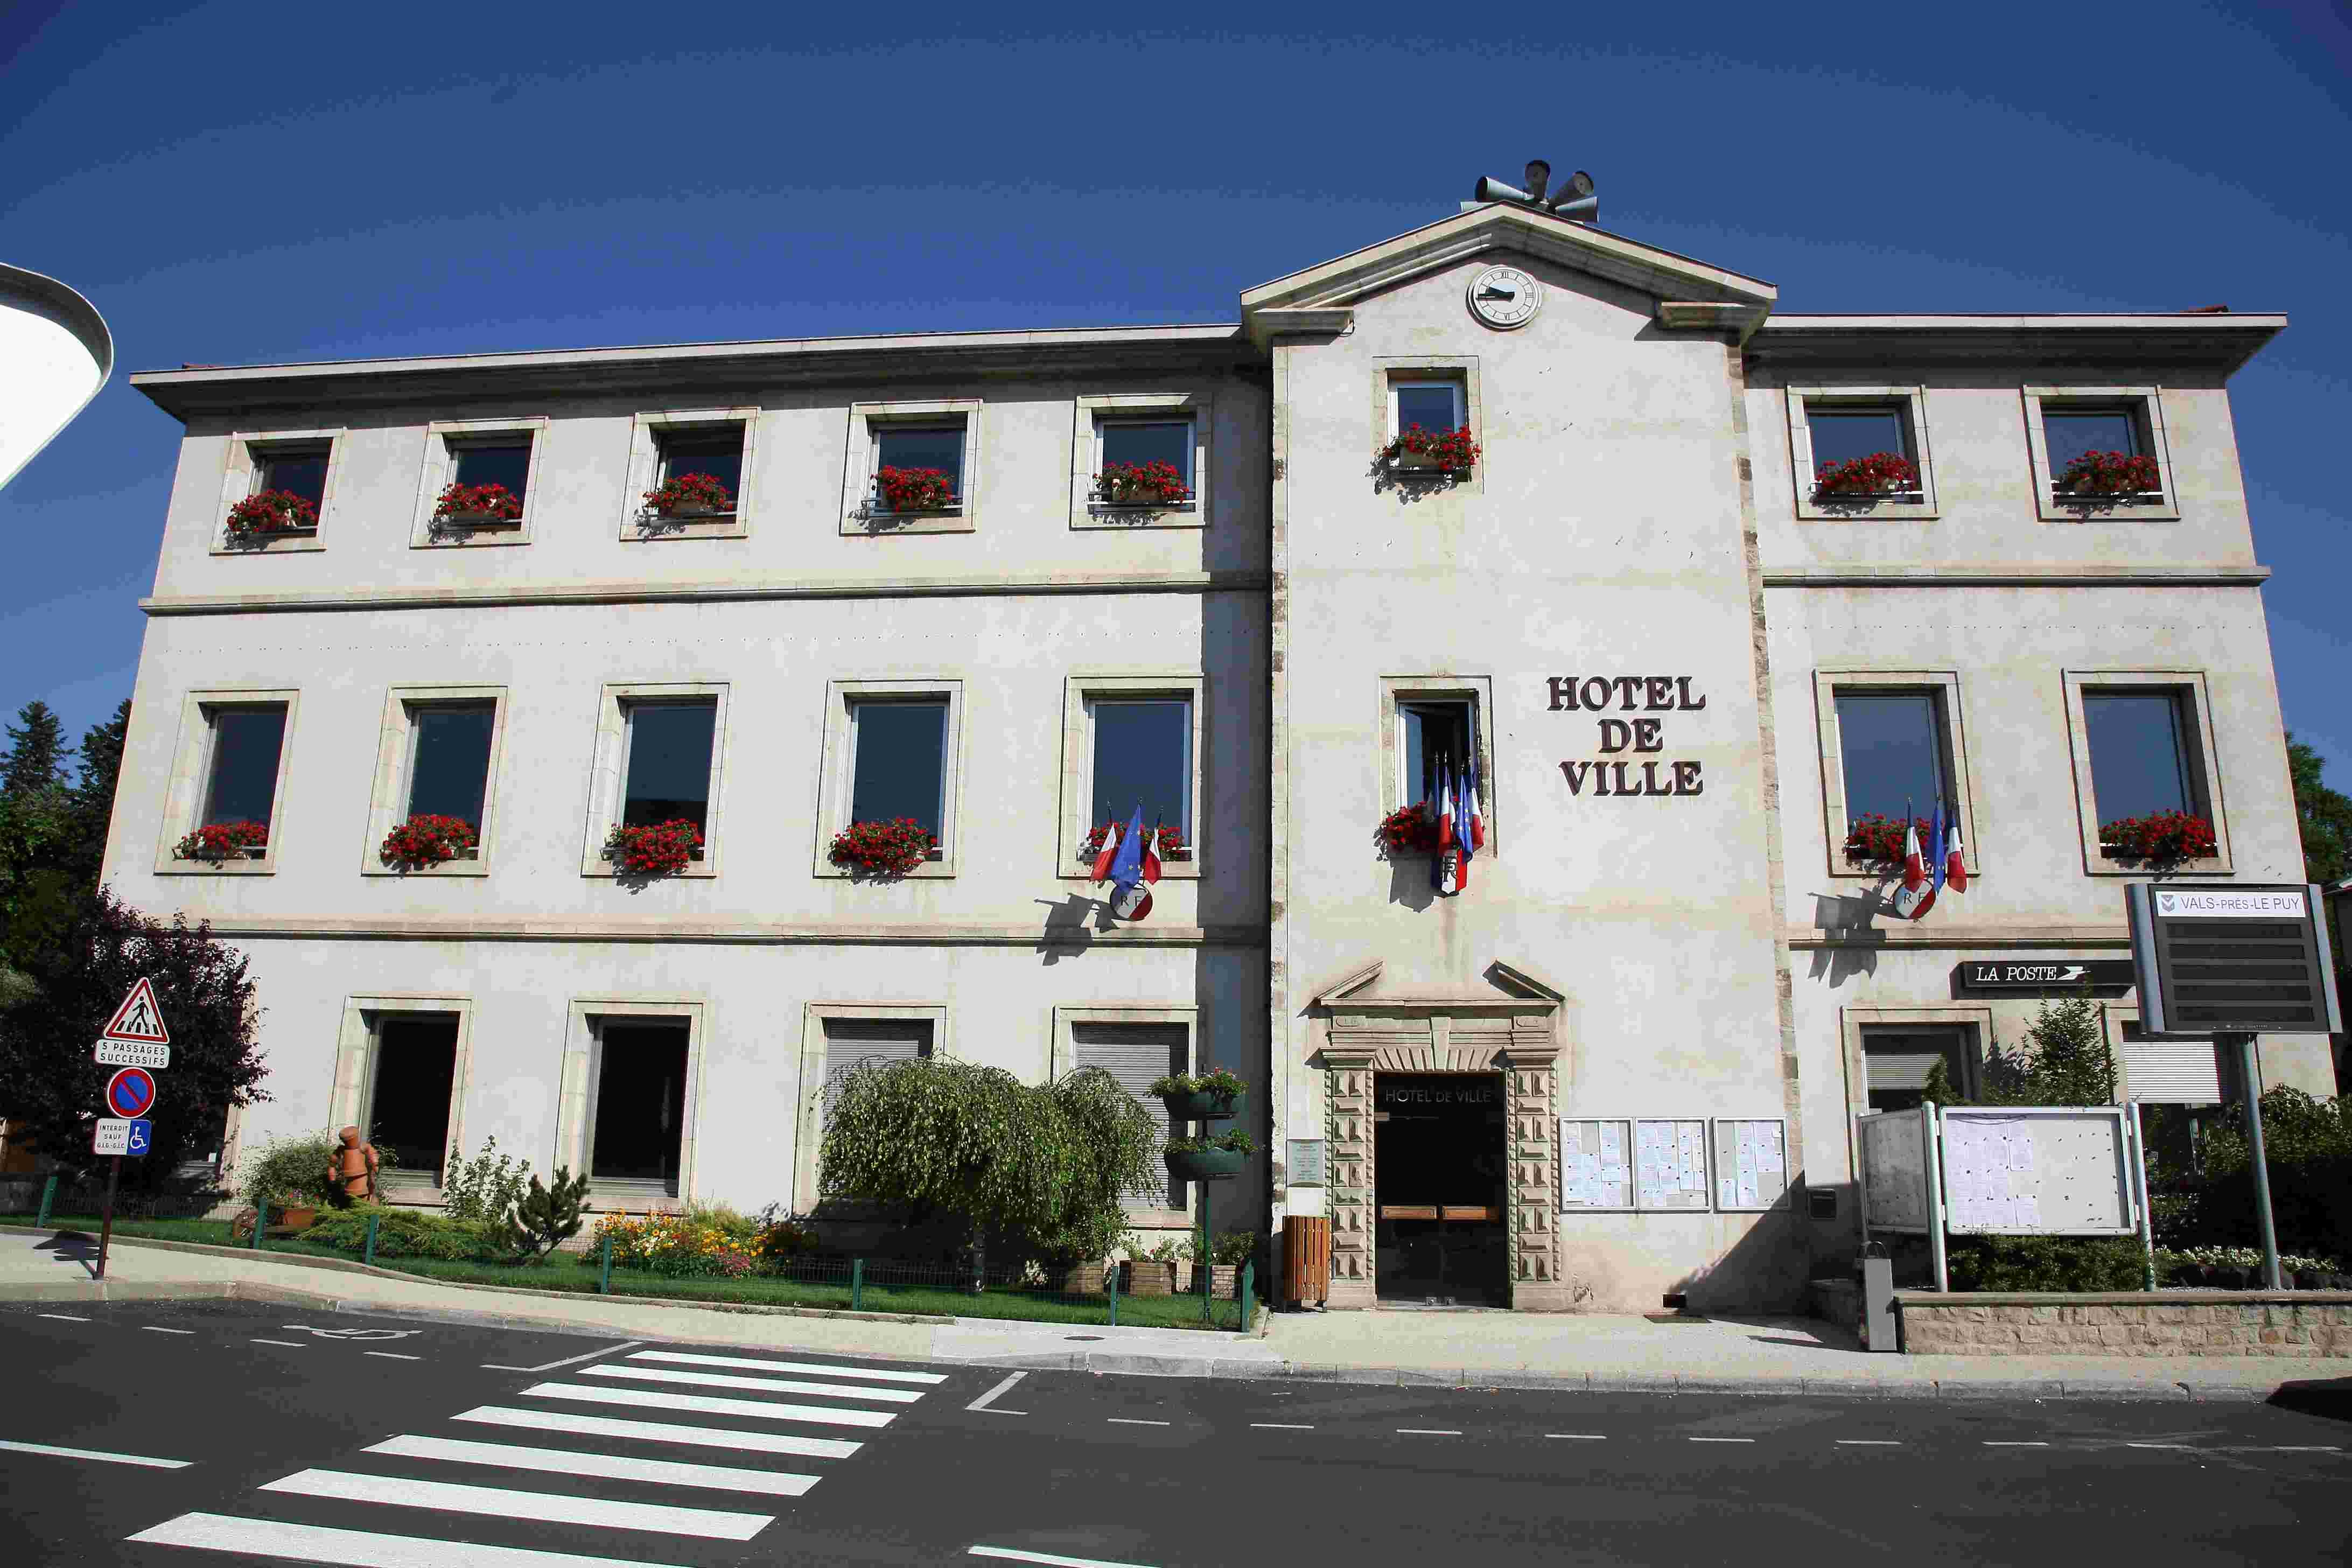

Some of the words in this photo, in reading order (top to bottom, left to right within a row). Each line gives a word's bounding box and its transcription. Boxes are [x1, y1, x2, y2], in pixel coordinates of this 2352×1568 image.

[1546, 676, 1706, 711] HOTEL
[1597, 718, 1663, 753] DE
[1559, 761, 1704, 796] VILLE
[2274, 898, 2299, 909] PUY
[1976, 967, 1999, 981] LA
[2006, 967, 2057, 981] POSTE
[113, 1043, 165, 1055] PASSAGES
[100, 1053, 164, 1066] SUCCESSIFS
[1385, 1090, 1432, 1102] HOTEL
[1436, 1091, 1452, 1102] DE
[1456, 1090, 1491, 1102] VILLE
